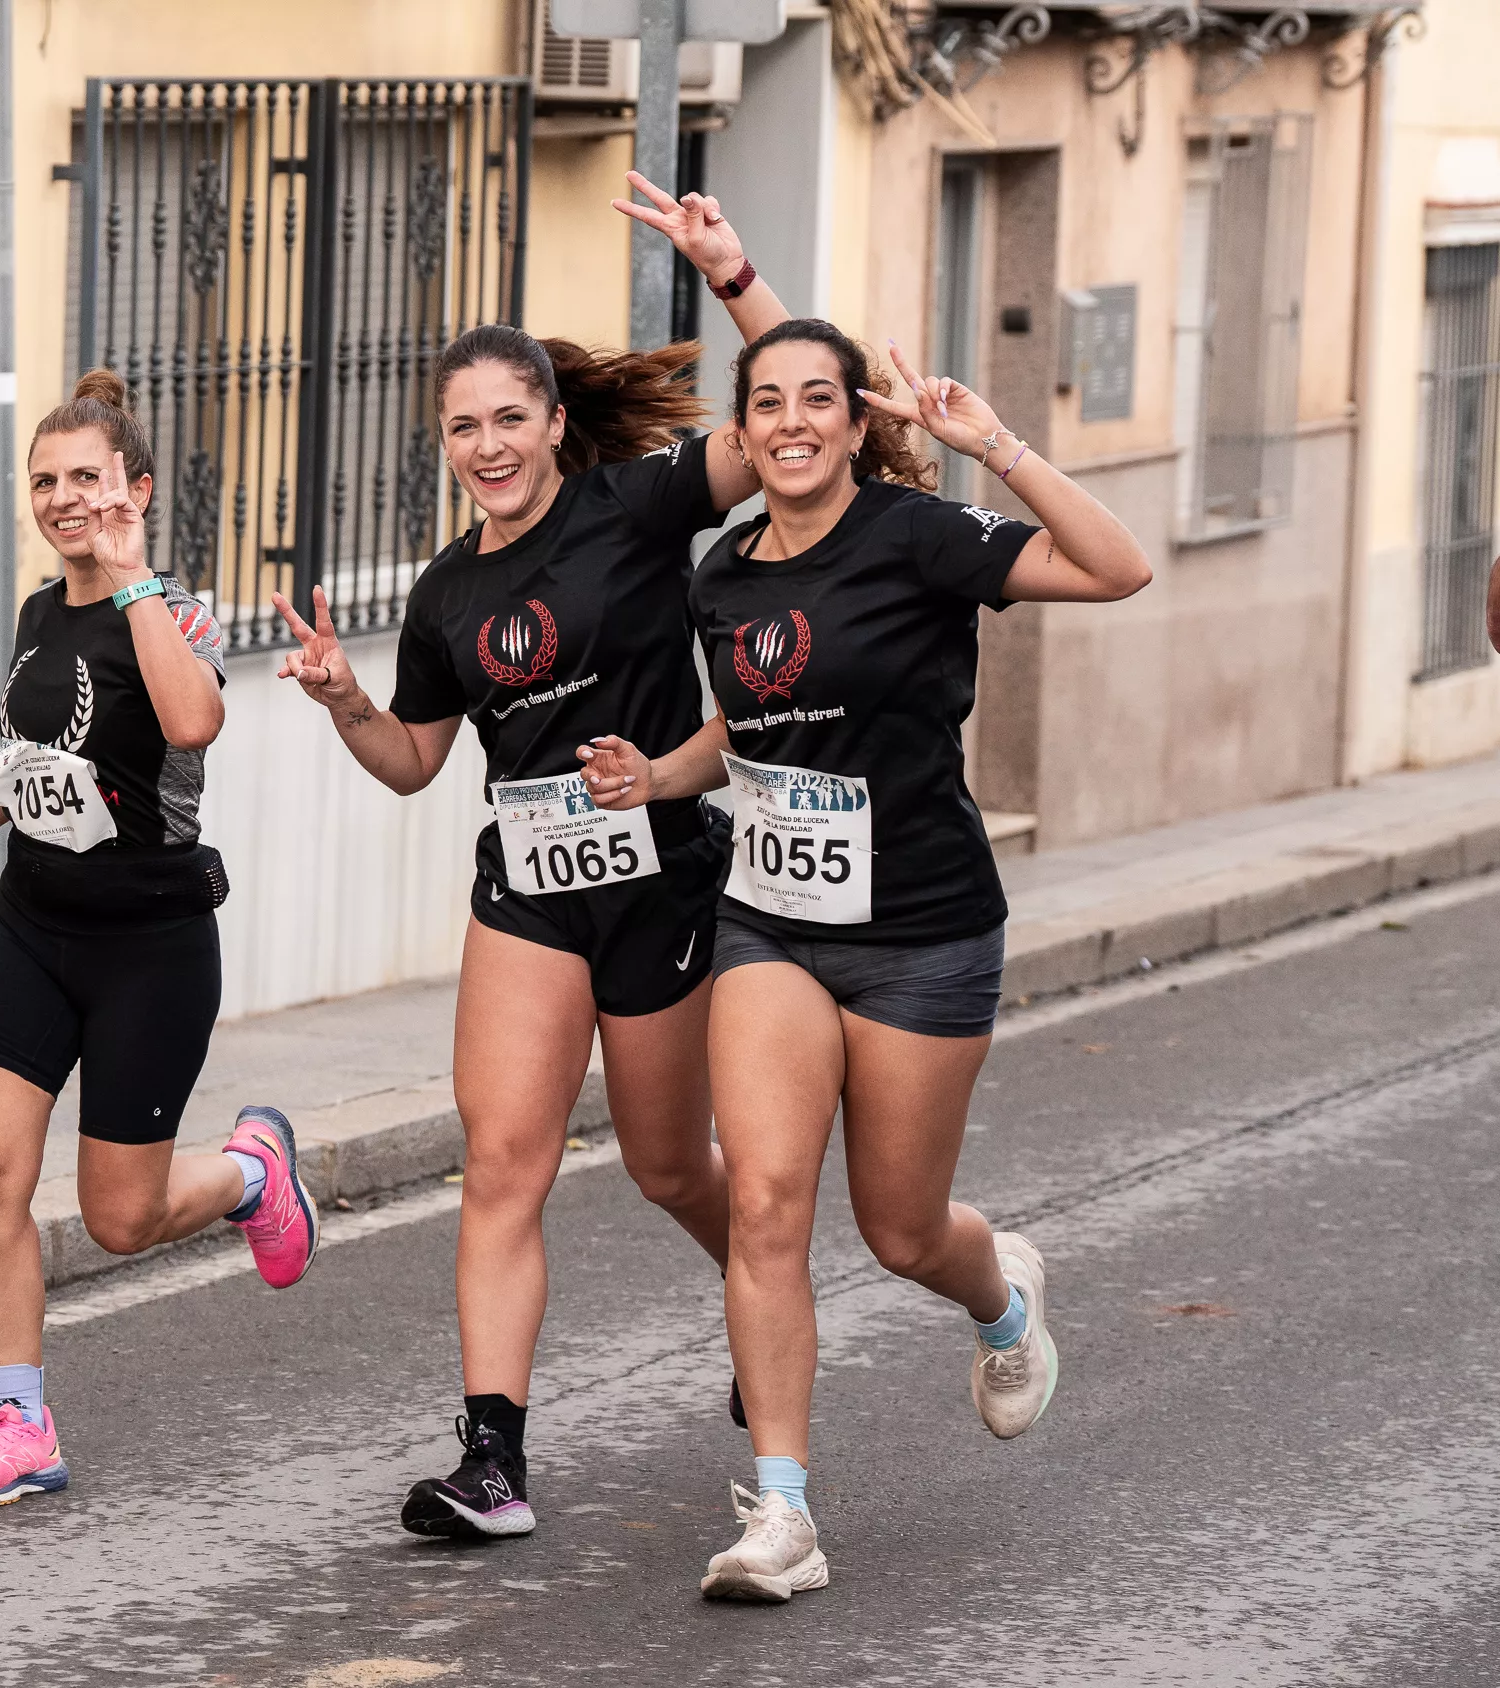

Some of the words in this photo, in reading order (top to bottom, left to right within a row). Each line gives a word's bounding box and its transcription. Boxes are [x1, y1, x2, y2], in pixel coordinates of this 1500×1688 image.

[528, 690, 555, 705] down
[566, 672, 599, 694] street
[727, 717, 763, 732] Running
[764, 712, 793, 727] down
[793, 707, 806, 722] the
[808, 706, 845, 722] street
[559, 778, 588, 796] 202
[788, 772, 833, 790] 2024
[14, 773, 85, 820] 1054
[527, 790, 561, 801] POPULARES
[583, 816, 608, 826] LUCENA
[780, 824, 812, 832] IGUALDAD
[564, 828, 594, 838] IGUALDAD
[525, 831, 639, 889] 1065
[744, 823, 851, 884] 1055
